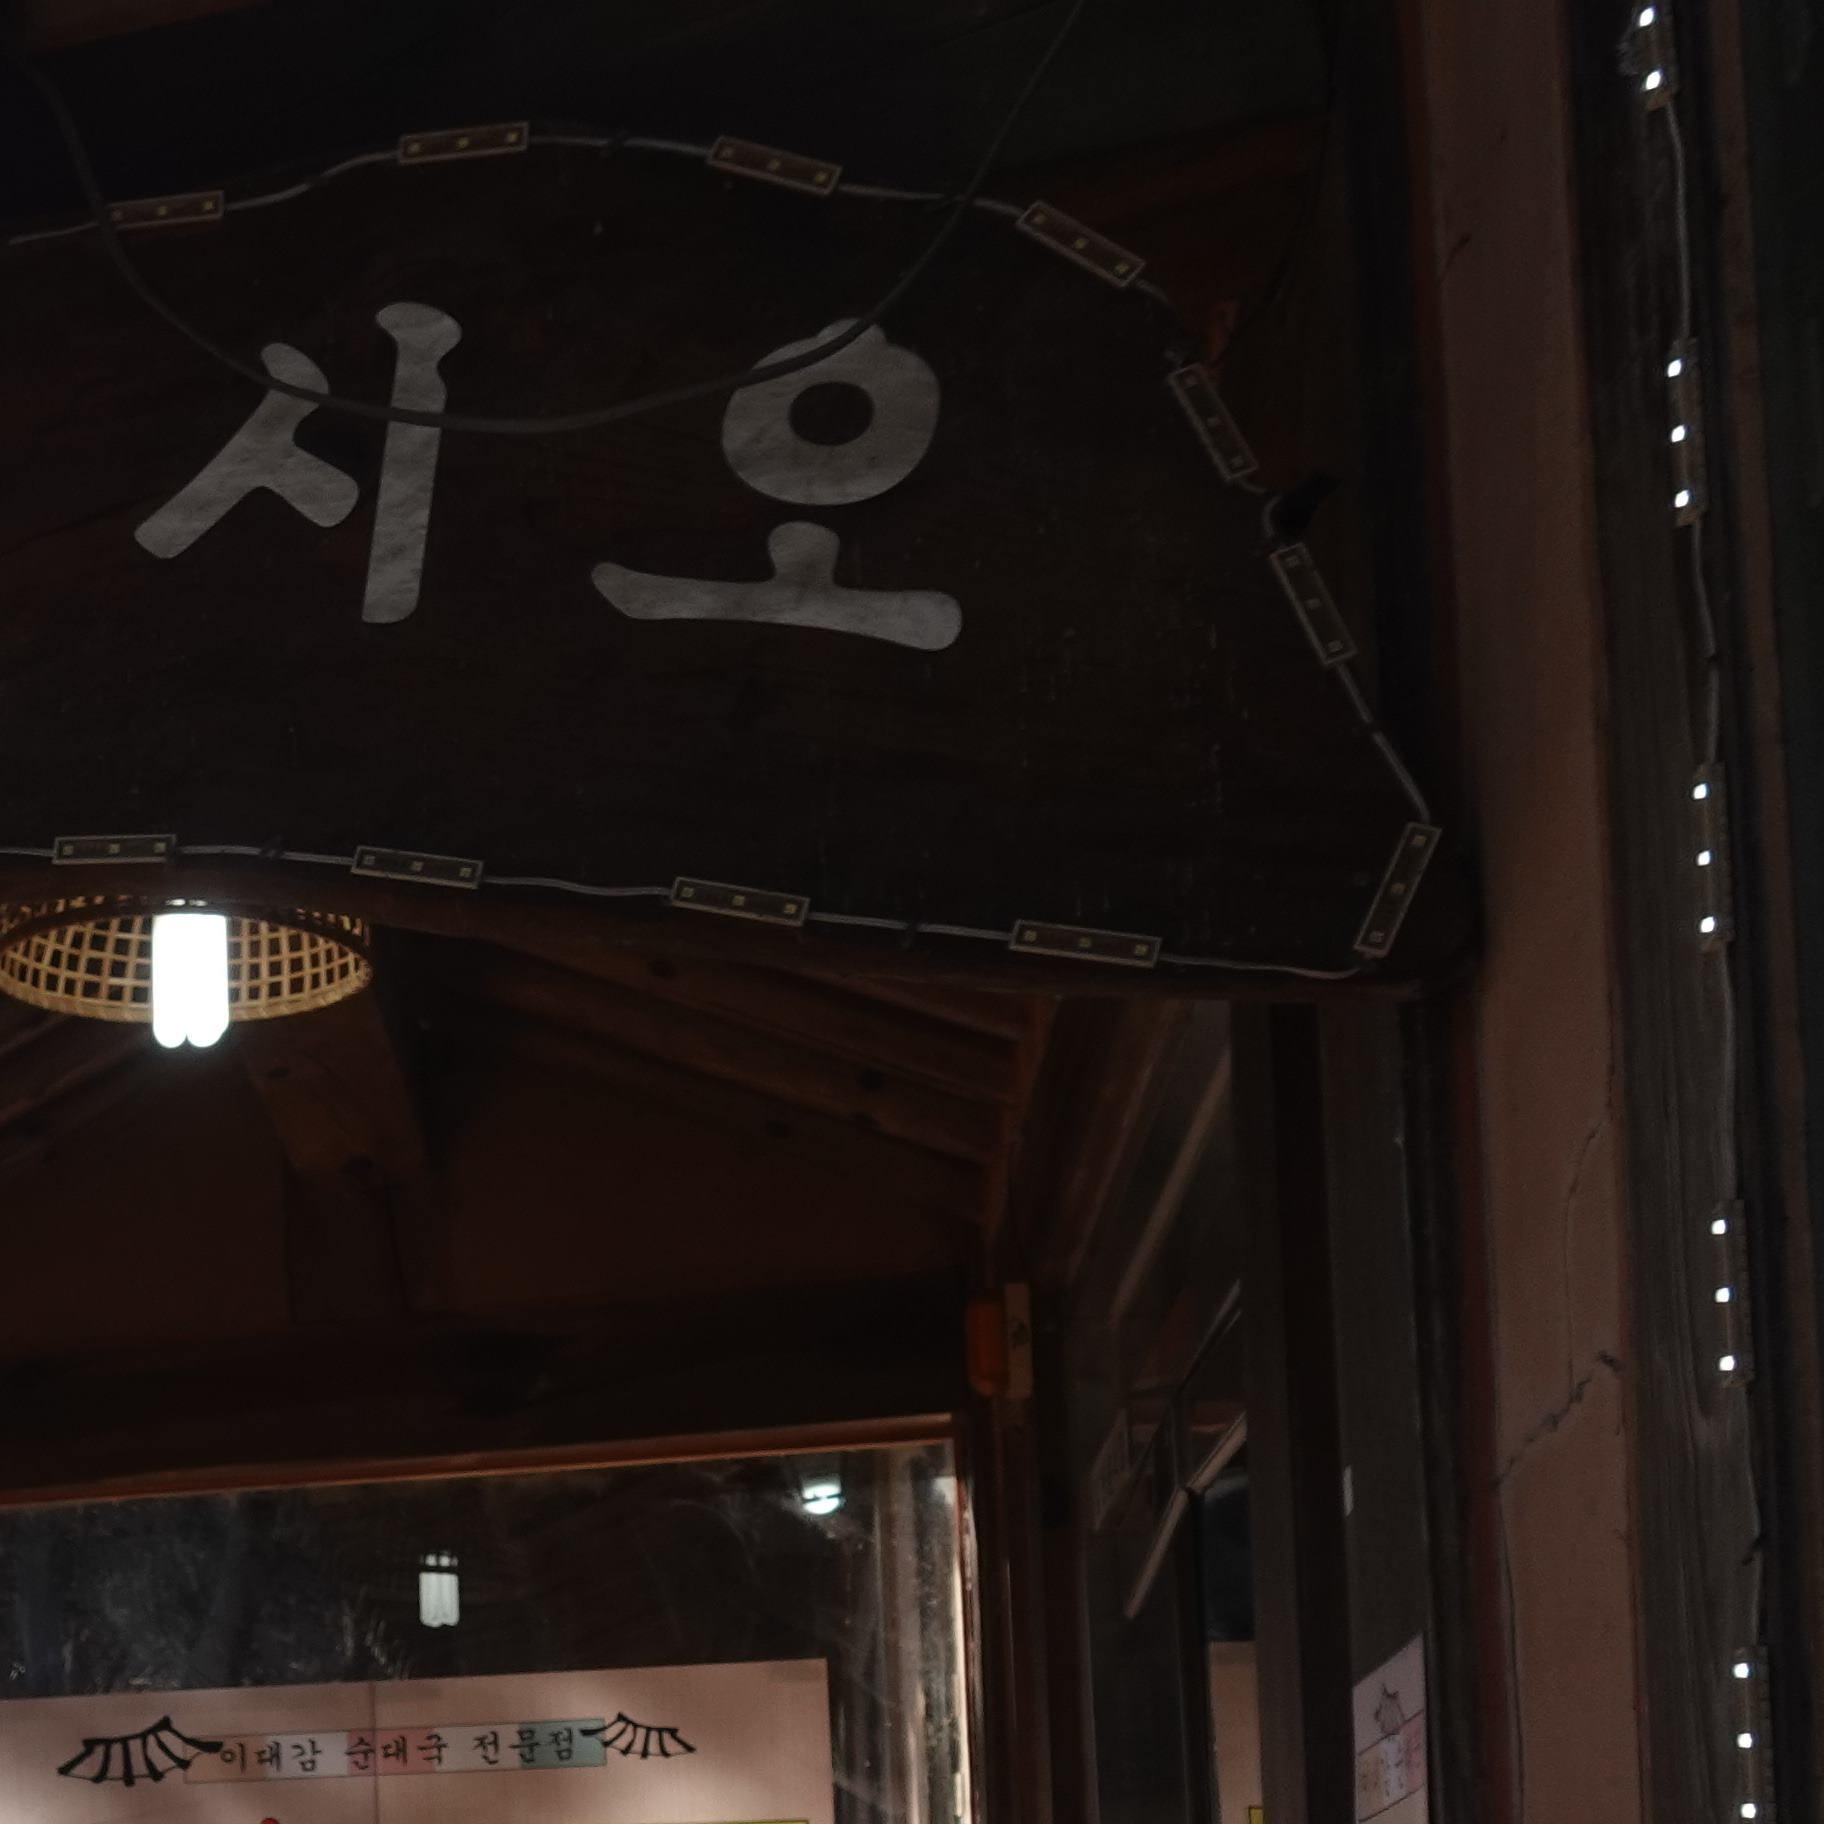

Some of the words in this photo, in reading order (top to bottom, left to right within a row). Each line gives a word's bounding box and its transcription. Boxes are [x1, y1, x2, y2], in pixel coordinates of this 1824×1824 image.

[220, 1739, 322, 1773] 이대감
[345, 1734, 449, 1770] 순대국
[472, 1728, 574, 1764] 전문점
